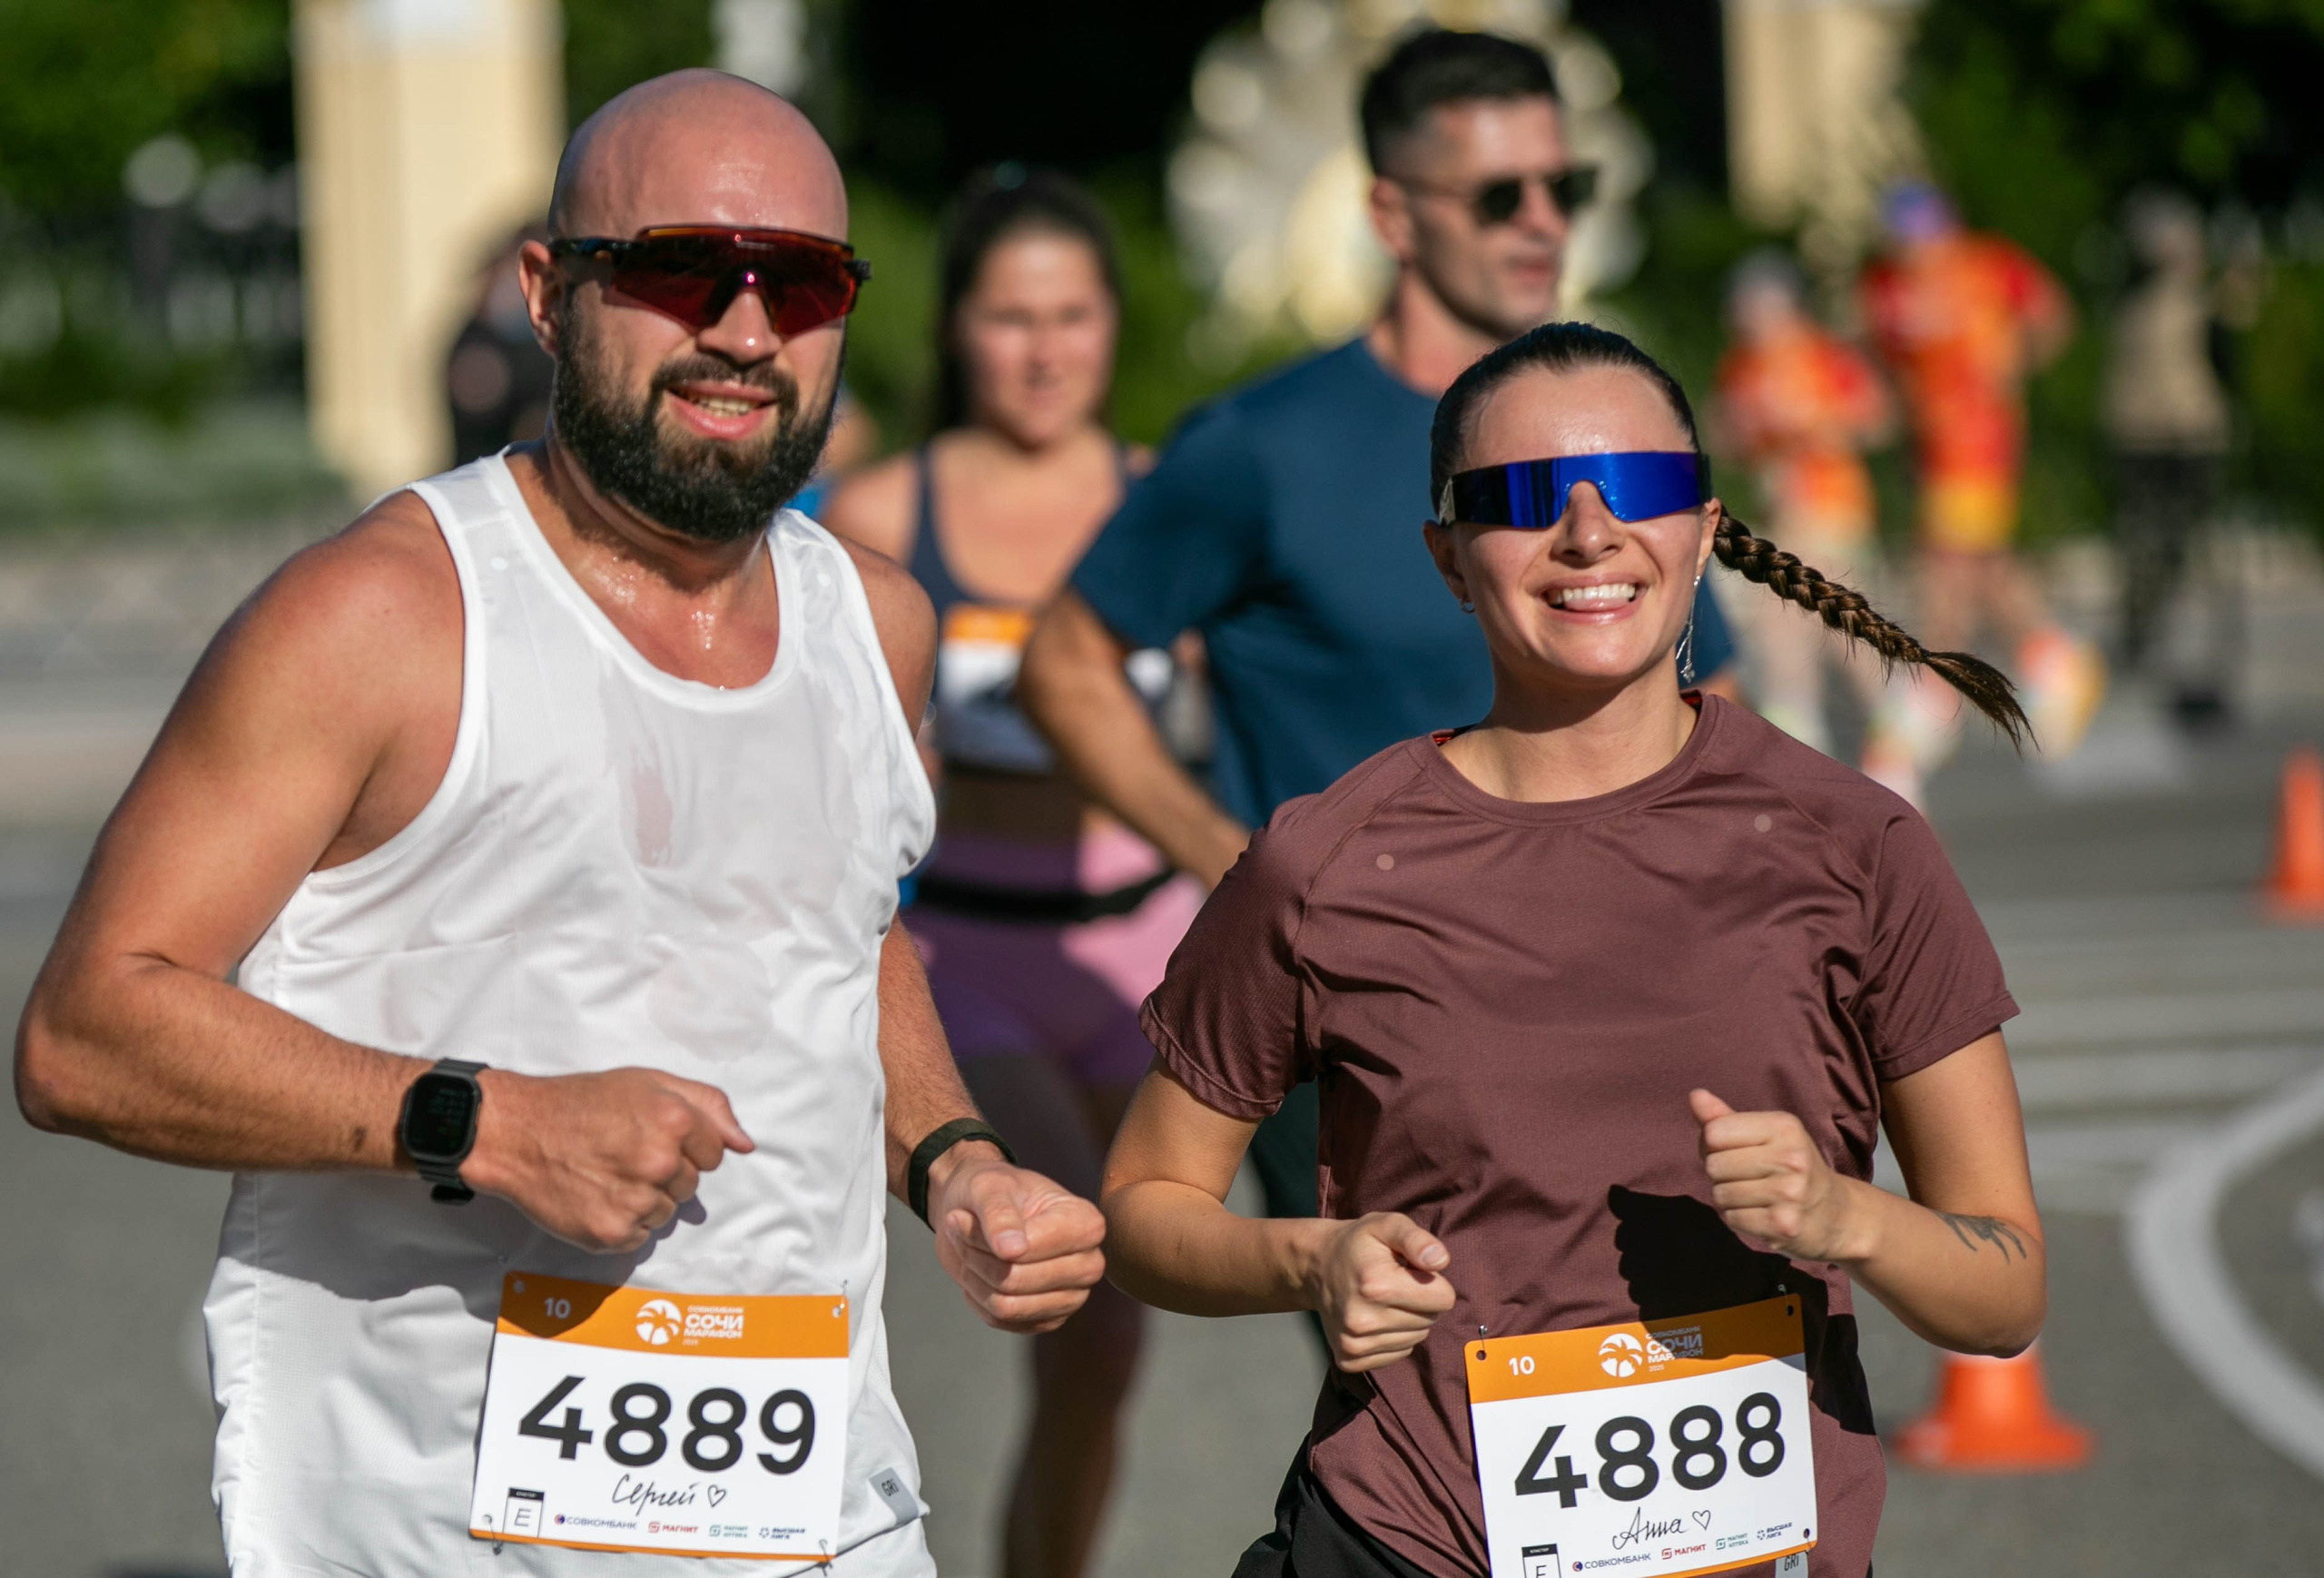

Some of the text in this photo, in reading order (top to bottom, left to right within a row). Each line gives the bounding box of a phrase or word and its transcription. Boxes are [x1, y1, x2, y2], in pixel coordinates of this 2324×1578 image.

[545, 1297, 571, 1319] 10
[685, 1314, 743, 1329] СОЧИ
[684, 1328, 743, 1339] МАРАФОН
[1646, 1333, 1702, 1355] СОЧИ
[1648, 1347, 1703, 1364] МАРАФОН
[1509, 1356, 1535, 1376] 10
[518, 1376, 816, 1475] 4889
[1514, 1392, 1785, 1509] 4888
[566, 1516, 637, 1530] СОВКОМБАНК
[662, 1524, 699, 1534] МАГНИТ
[1612, 1506, 1689, 1550] Анна
[1766, 1522, 1793, 1534] ВЫСШАЯ
[1674, 1543, 1707, 1556] МАГНИТ
[1584, 1553, 1652, 1570] СОВКОМБАНК
